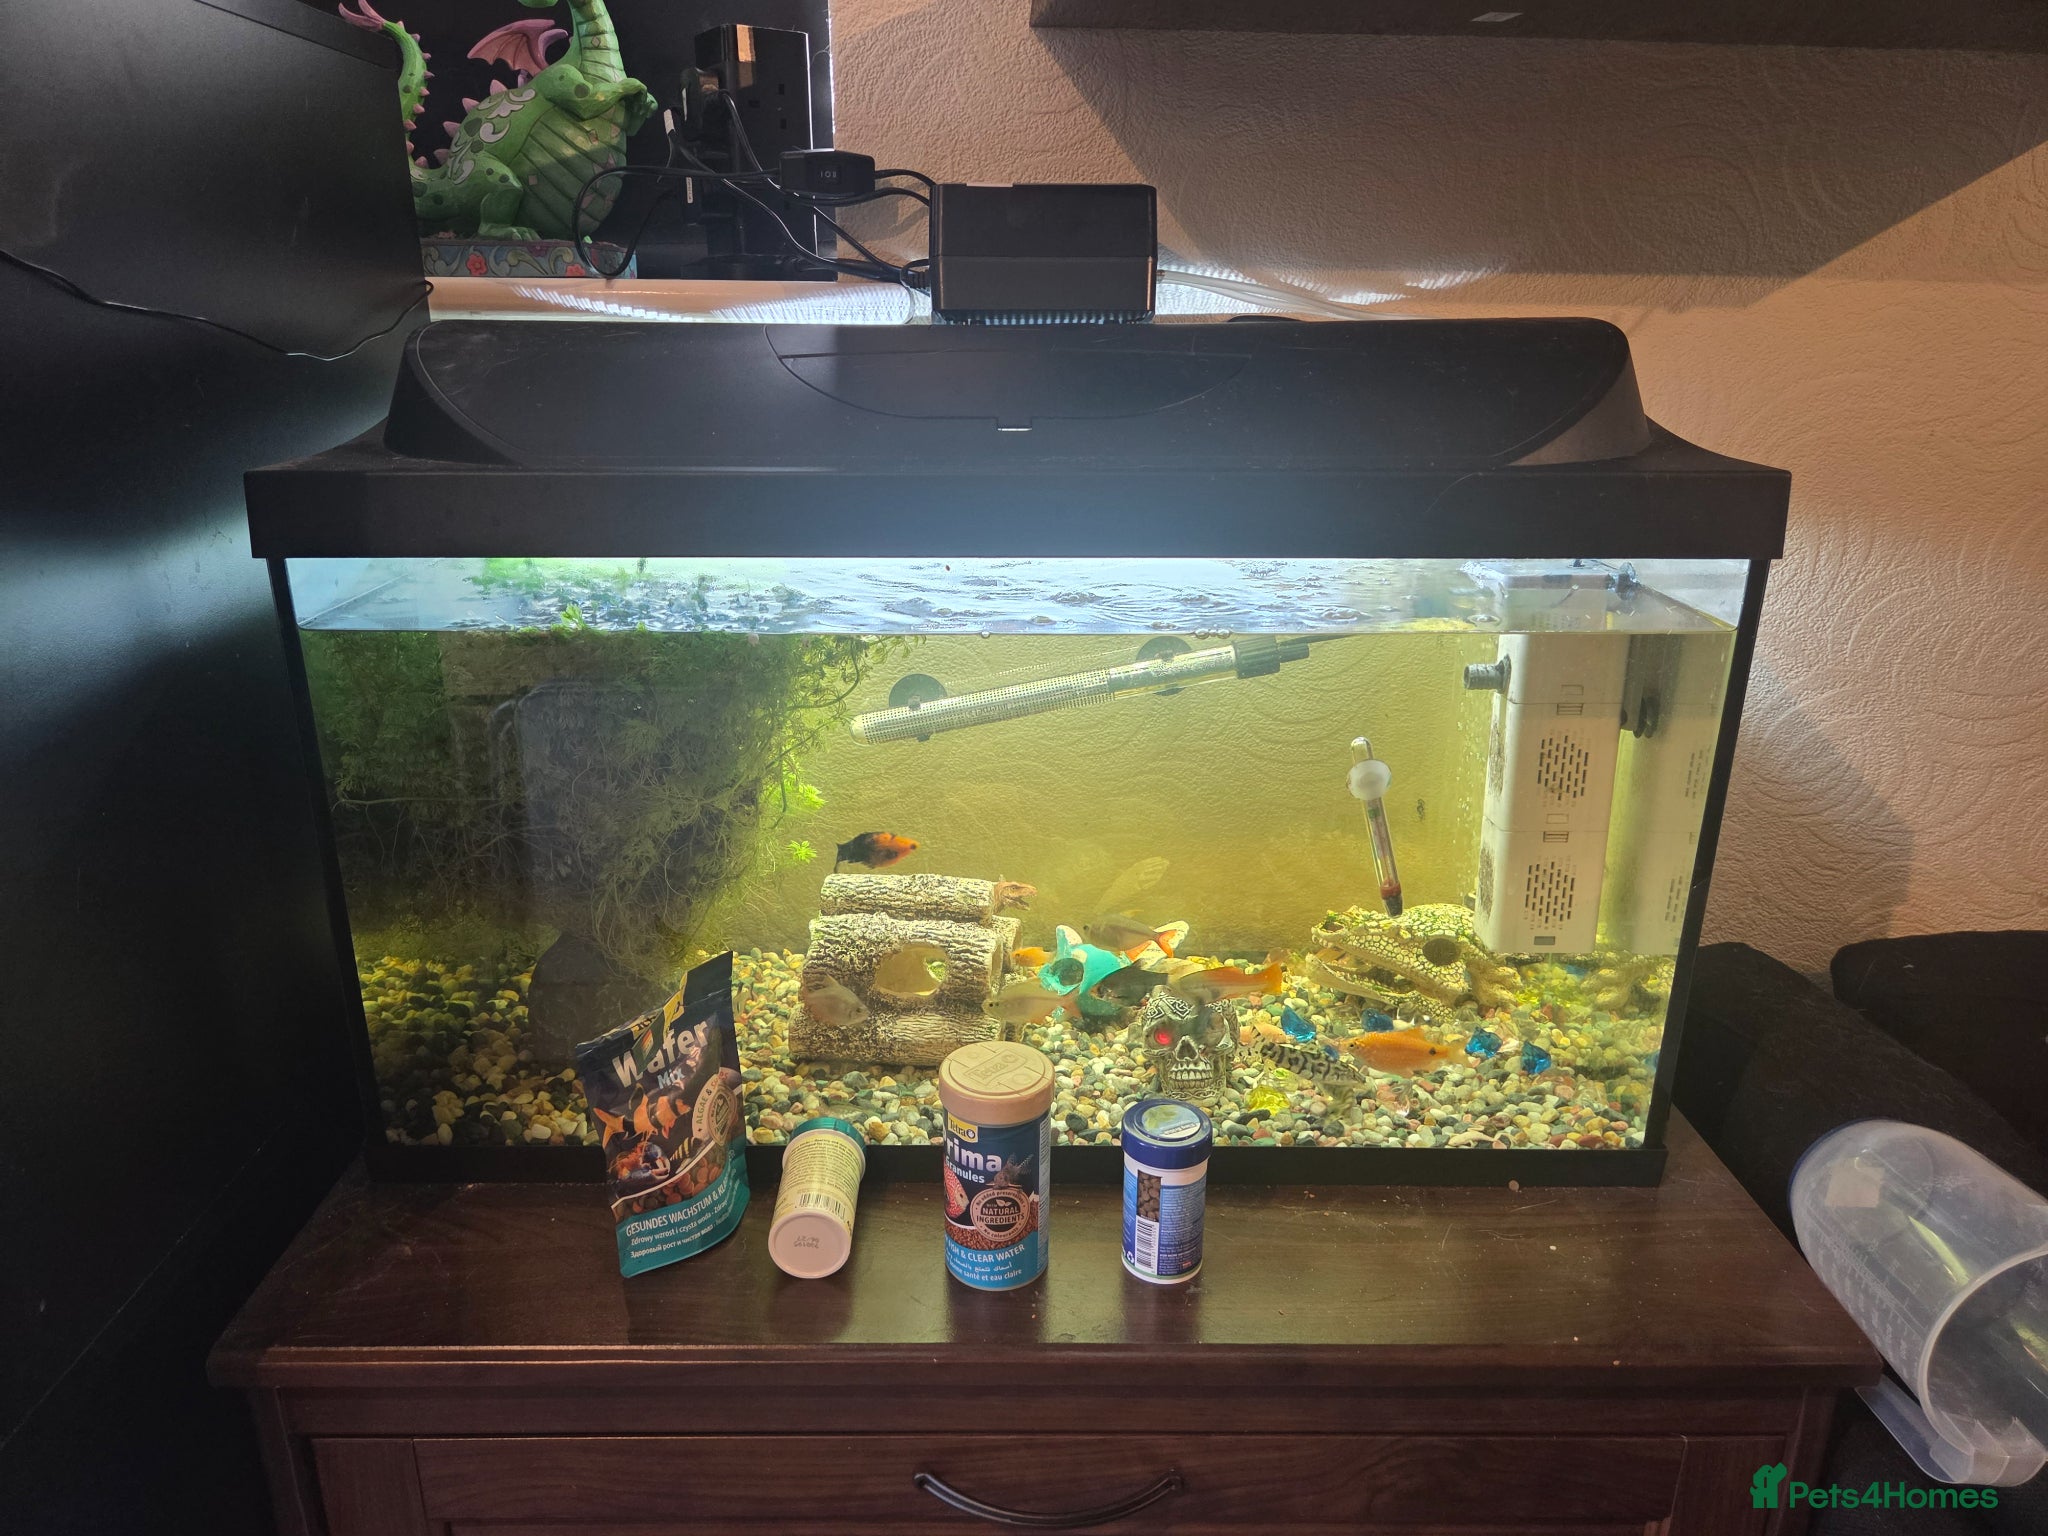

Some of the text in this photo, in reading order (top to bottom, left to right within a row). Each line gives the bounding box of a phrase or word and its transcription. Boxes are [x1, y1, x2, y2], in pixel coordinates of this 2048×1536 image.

[612, 1021, 708, 1088] Wafer
[657, 1068, 685, 1090] Mix
[696, 1096, 708, 1124] ALGAE
[950, 1118, 966, 1136] Tetra
[946, 1155, 985, 1184] Granules
[626, 1214, 668, 1236] GESUNDES
[668, 1196, 713, 1223] WACHSTUM
[976, 1214, 1024, 1224] INGREDIENTS
[982, 1206, 1019, 1215] NATURAL
[654, 1228, 675, 1239] wzrost
[968, 1252, 994, 1262] CLEAR
[996, 1244, 1025, 1260] WATER
[1004, 1269, 1022, 1279] claire
